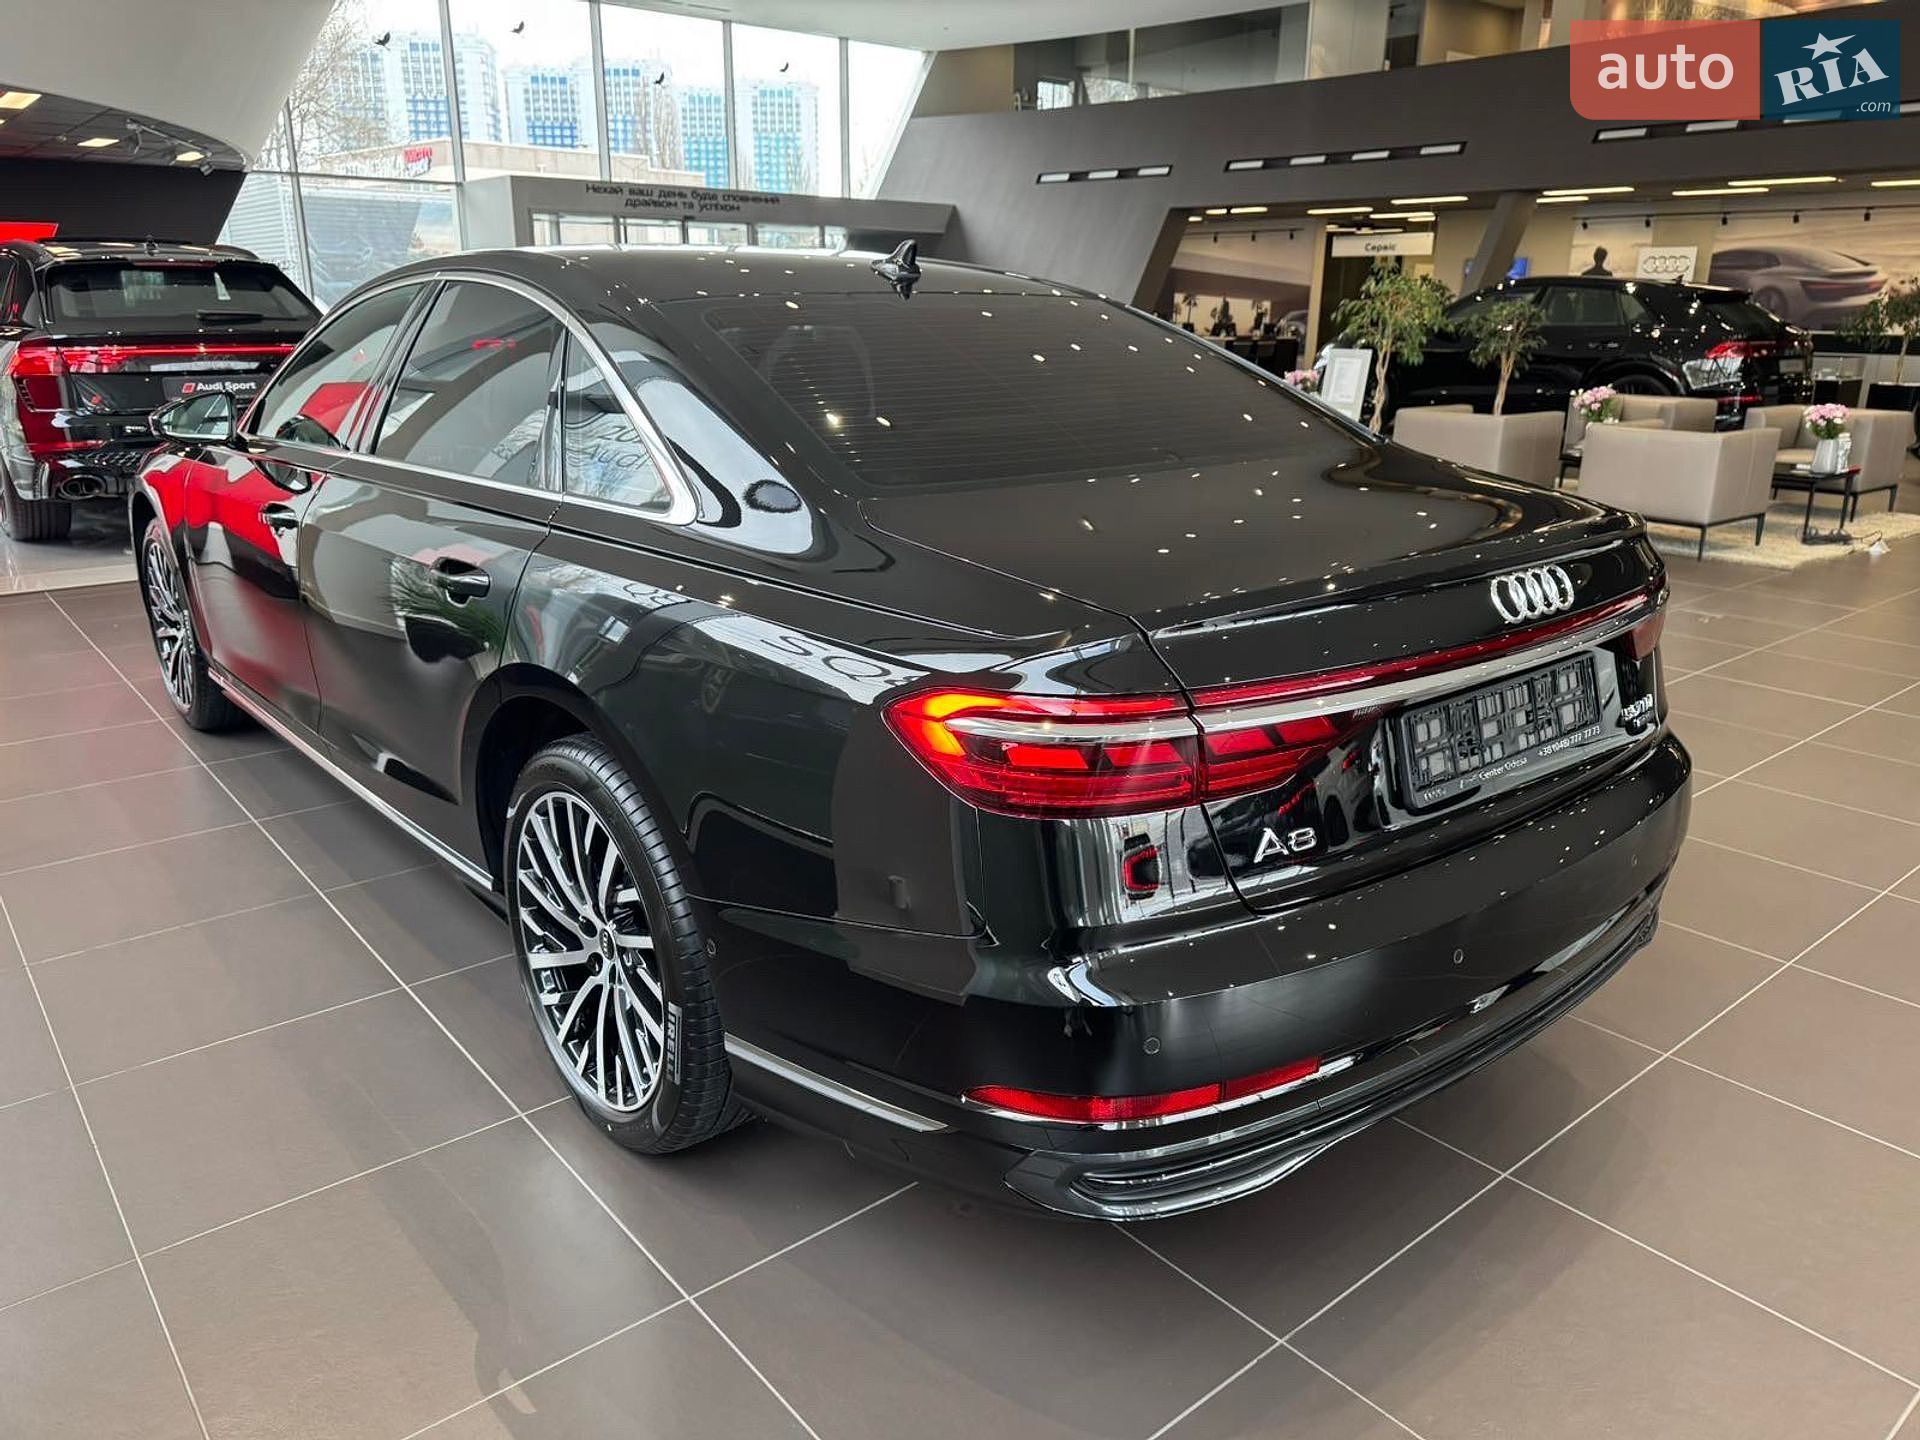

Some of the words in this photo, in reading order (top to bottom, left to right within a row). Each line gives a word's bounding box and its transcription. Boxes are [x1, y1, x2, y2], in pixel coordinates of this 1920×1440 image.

[586, 183, 623, 195] Нехай
[629, 188, 653, 197] ваш
[658, 189, 687, 199] день
[691, 190, 718, 201] буде
[625, 197, 678, 209] драйвом
[682, 200, 694, 210] та
[699, 201, 741, 213] успіхом
[1364, 242, 1397, 253] Сервіс
[196, 381, 223, 391] Audi
[224, 381, 257, 392] Sport
[1253, 827, 1318, 864] A8
